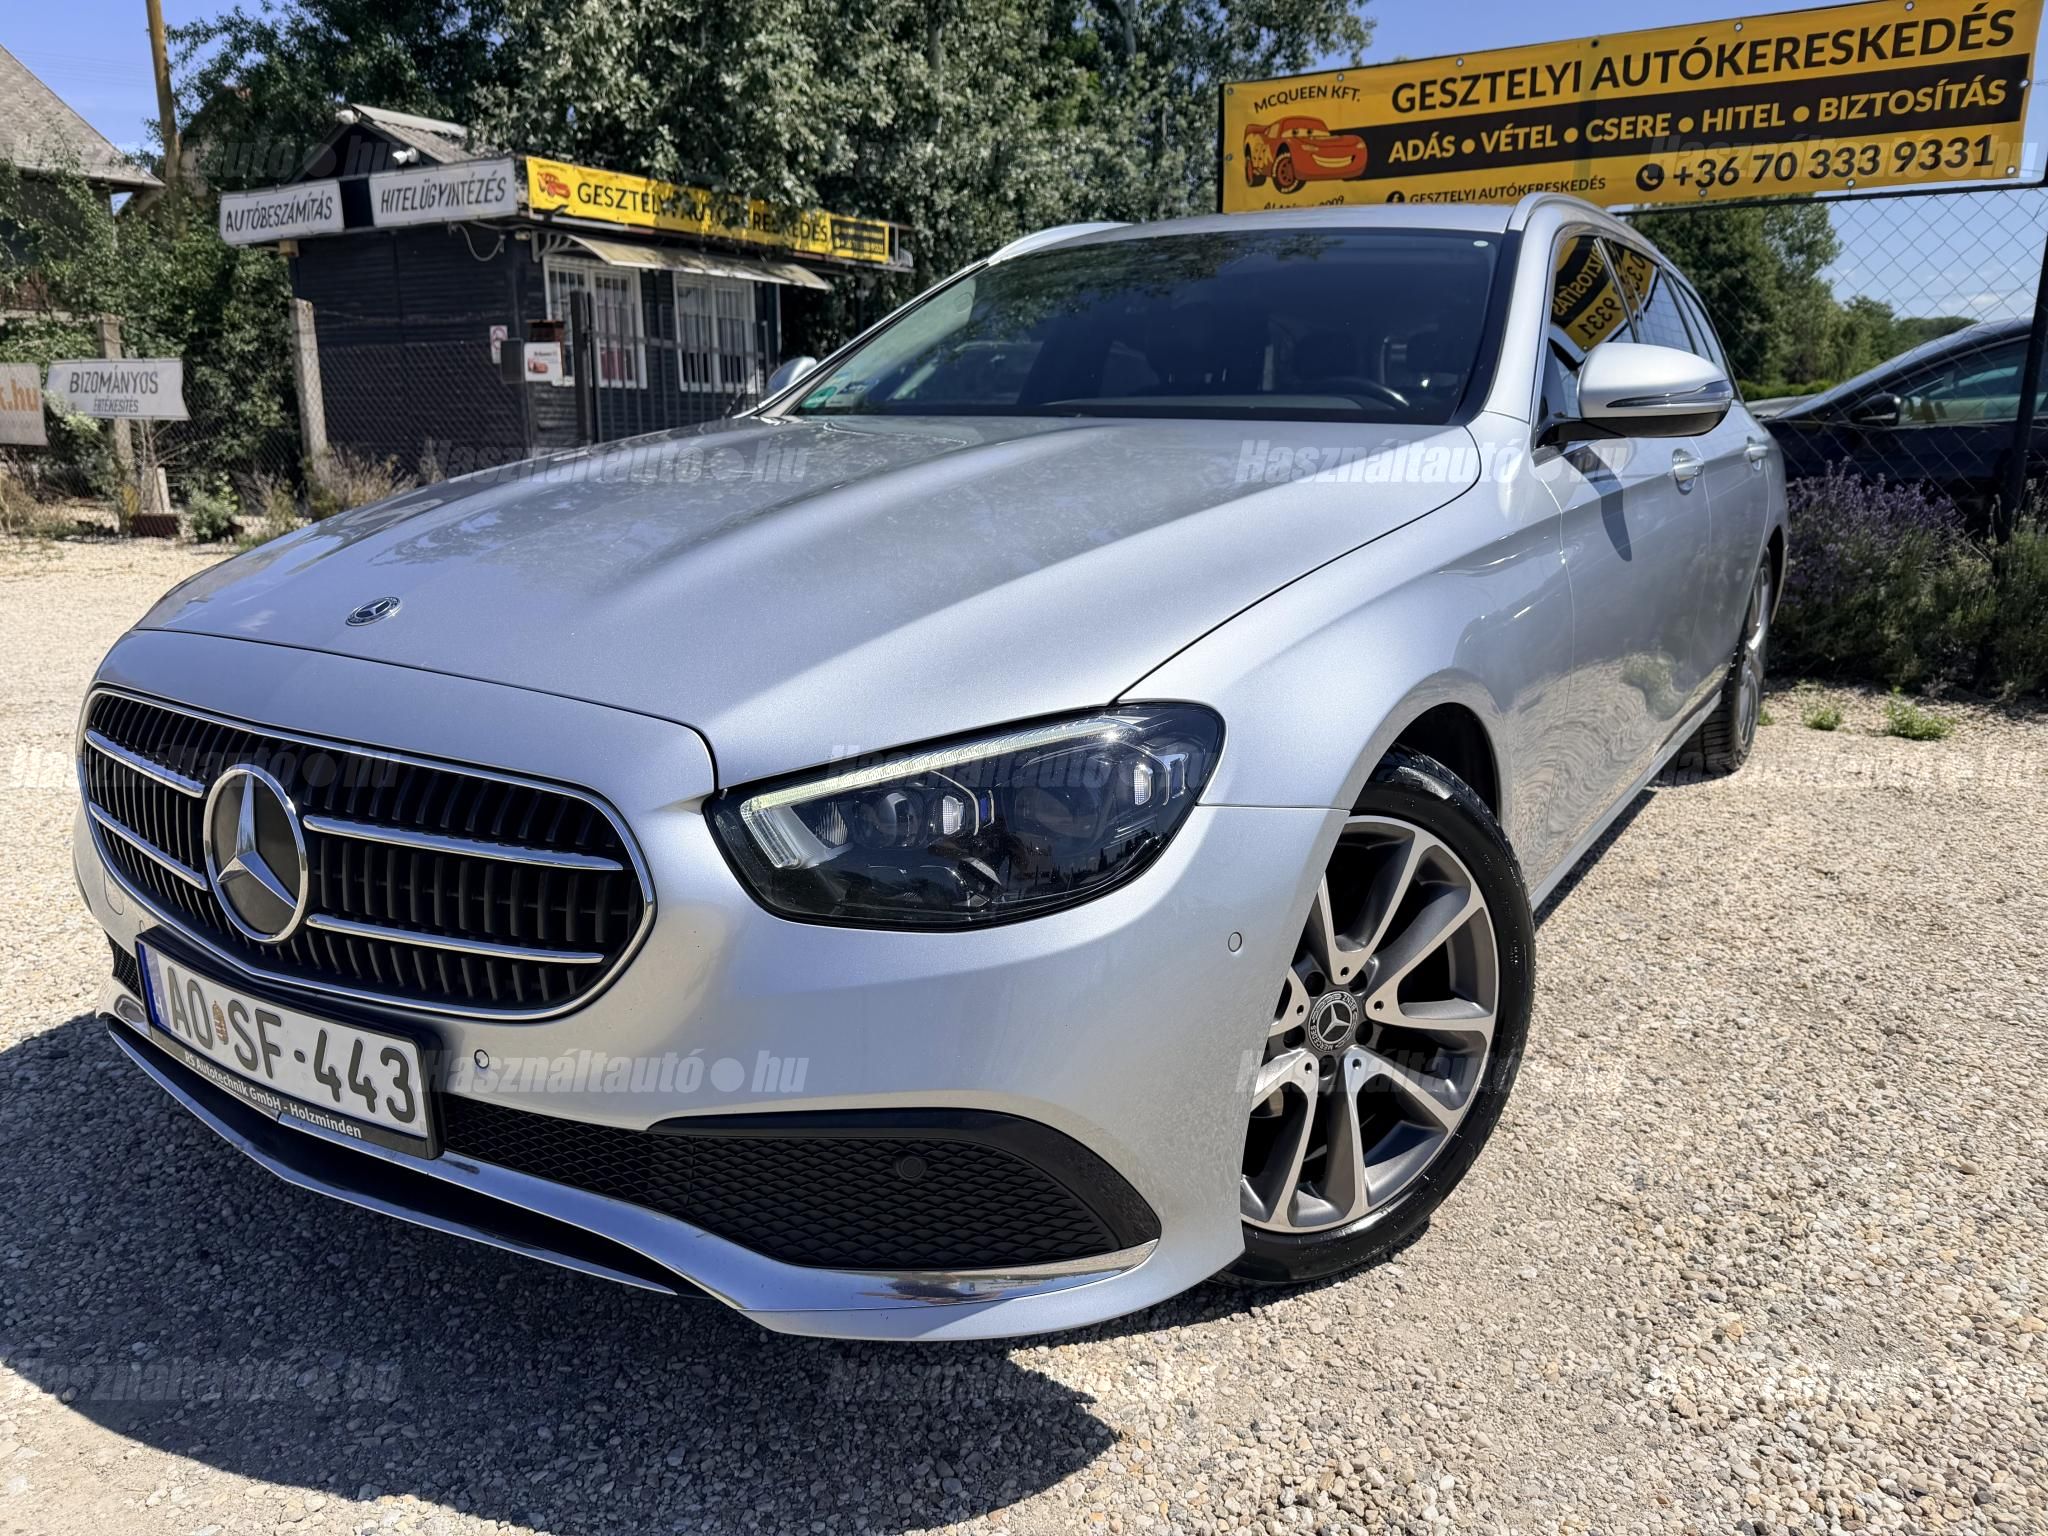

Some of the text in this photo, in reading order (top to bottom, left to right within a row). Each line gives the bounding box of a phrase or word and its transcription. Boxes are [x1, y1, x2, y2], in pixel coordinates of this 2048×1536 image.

[1392, 3, 2016, 114] GESZTELYI AUTÓKERESKEDÉS
[1254, 85, 1361, 113] MCQUEEN KFT.
[1388, 74, 2007, 163] ADÁS VÉTEL CSERE HITEL BIZTOSÍTÁS
[1672, 134, 1994, 188] +36 70 333 9331
[226, 190, 333, 232] AUTÓBESZÁMÍTÁS
[381, 170, 506, 214] HITELÜGYINTÉZÉS
[70, 365, 158, 394] BIZOMÁNYOS
[167, 966, 416, 1124] AO SF-443
[196, 1060, 249, 1097] Autotechnik
[250, 1087, 282, 1111] GmbH
[289, 1103, 362, 1139] Holzminden
